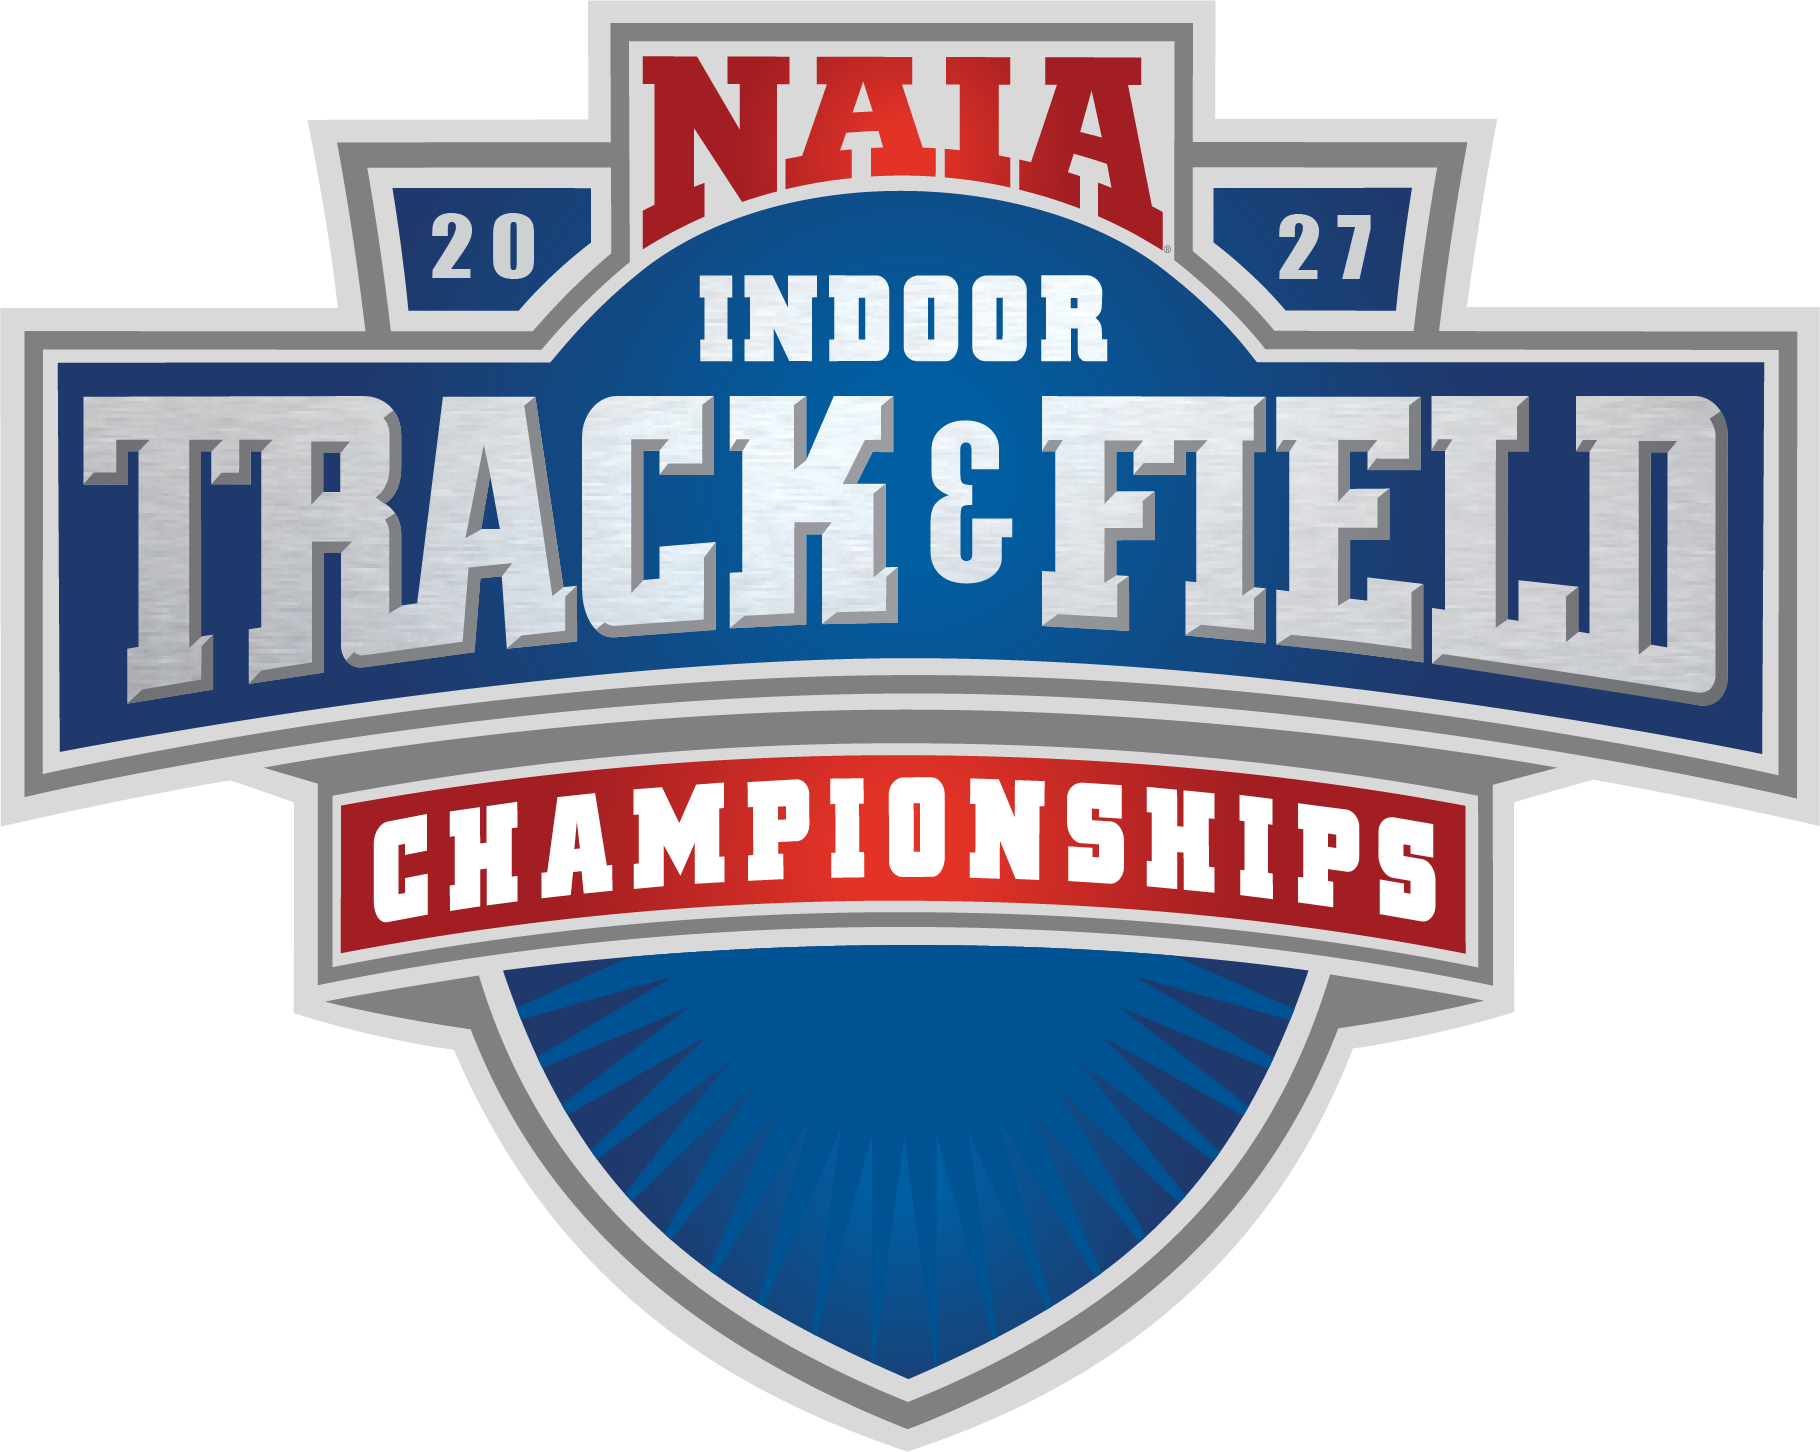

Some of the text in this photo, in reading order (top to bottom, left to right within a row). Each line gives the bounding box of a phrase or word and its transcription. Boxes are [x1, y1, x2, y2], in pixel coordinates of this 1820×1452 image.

[643, 56, 1163, 250] NAIA
[431, 213, 535, 280] 20
[1278, 213, 1372, 280] 27
[699, 274, 1108, 362] INDOOR
[83, 395, 1729, 707] TRACK & FIELD
[373, 777, 1437, 923] CHAMPIONSHIPS
